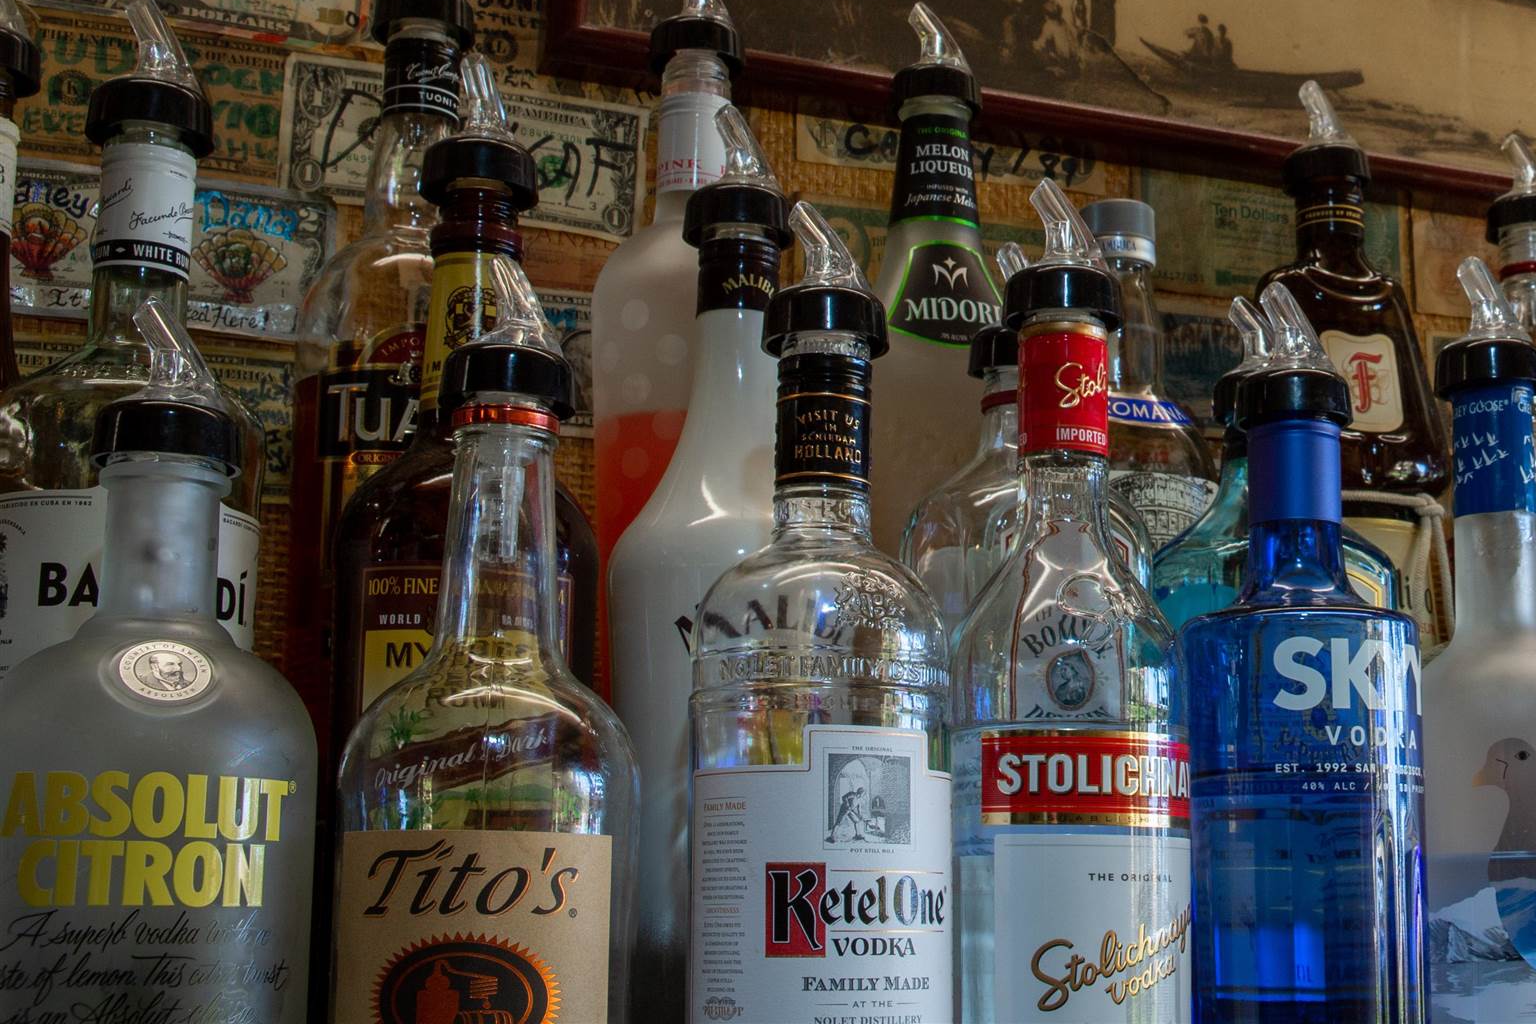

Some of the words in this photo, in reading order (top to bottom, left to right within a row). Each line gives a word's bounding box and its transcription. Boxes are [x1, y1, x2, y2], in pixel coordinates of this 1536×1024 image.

[225, 52, 286, 72] AMERIC
[419, 90, 453, 108] TUONI
[934, 126, 968, 139] ORIGINA
[915, 142, 970, 162] MELON
[909, 158, 974, 182] LIQUEUR
[904, 191, 952, 207] Japanese
[952, 193, 977, 209] Melo
[1212, 201, 1238, 219] Ten
[1239, 204, 1290, 224] Dollars
[133, 243, 174, 262] WHITE
[328, 382, 421, 443] TUA
[1468, 399, 1505, 414] GOOSE
[795, 408, 839, 426] VISIT
[843, 412, 861, 430] US
[1055, 426, 1106, 447] IMPORTED
[793, 445, 863, 464] HOLLAND
[38, 562, 248, 627] BADÍ
[368, 575, 400, 596] 100%
[403, 577, 440, 595] FINE
[378, 613, 422, 625] WORLD
[123, 642, 158, 672] COUNTRY
[1324, 724, 1418, 751] VODKA
[996, 751, 1191, 799] STOLICHNAY
[1274, 763, 1306, 774] EST.
[1316, 761, 1348, 774] 1992
[1354, 762, 1377, 774] SAN
[1301, 780, 1326, 792] 40%
[1333, 780, 1357, 792] ALC
[0, 770, 290, 842] ABSOLUT
[725, 800, 747, 811] MADE
[17, 838, 266, 908] CITRON
[363, 838, 579, 919] Tito's
[1087, 872, 1115, 882] THE
[1120, 872, 1173, 884] ORIGINAL
[767, 868, 890, 951] Ketel
[893, 874, 946, 926] One
[48, 909, 140, 954] superb
[134, 910, 200, 946] vodka
[831, 936, 917, 959] VODKA
[801, 975, 879, 993] FAMILY
[884, 974, 930, 991] MADE
[1105, 953, 1176, 1005] vodka
[851, 1000, 866, 1009] AT
[871, 999, 894, 1009] THE
